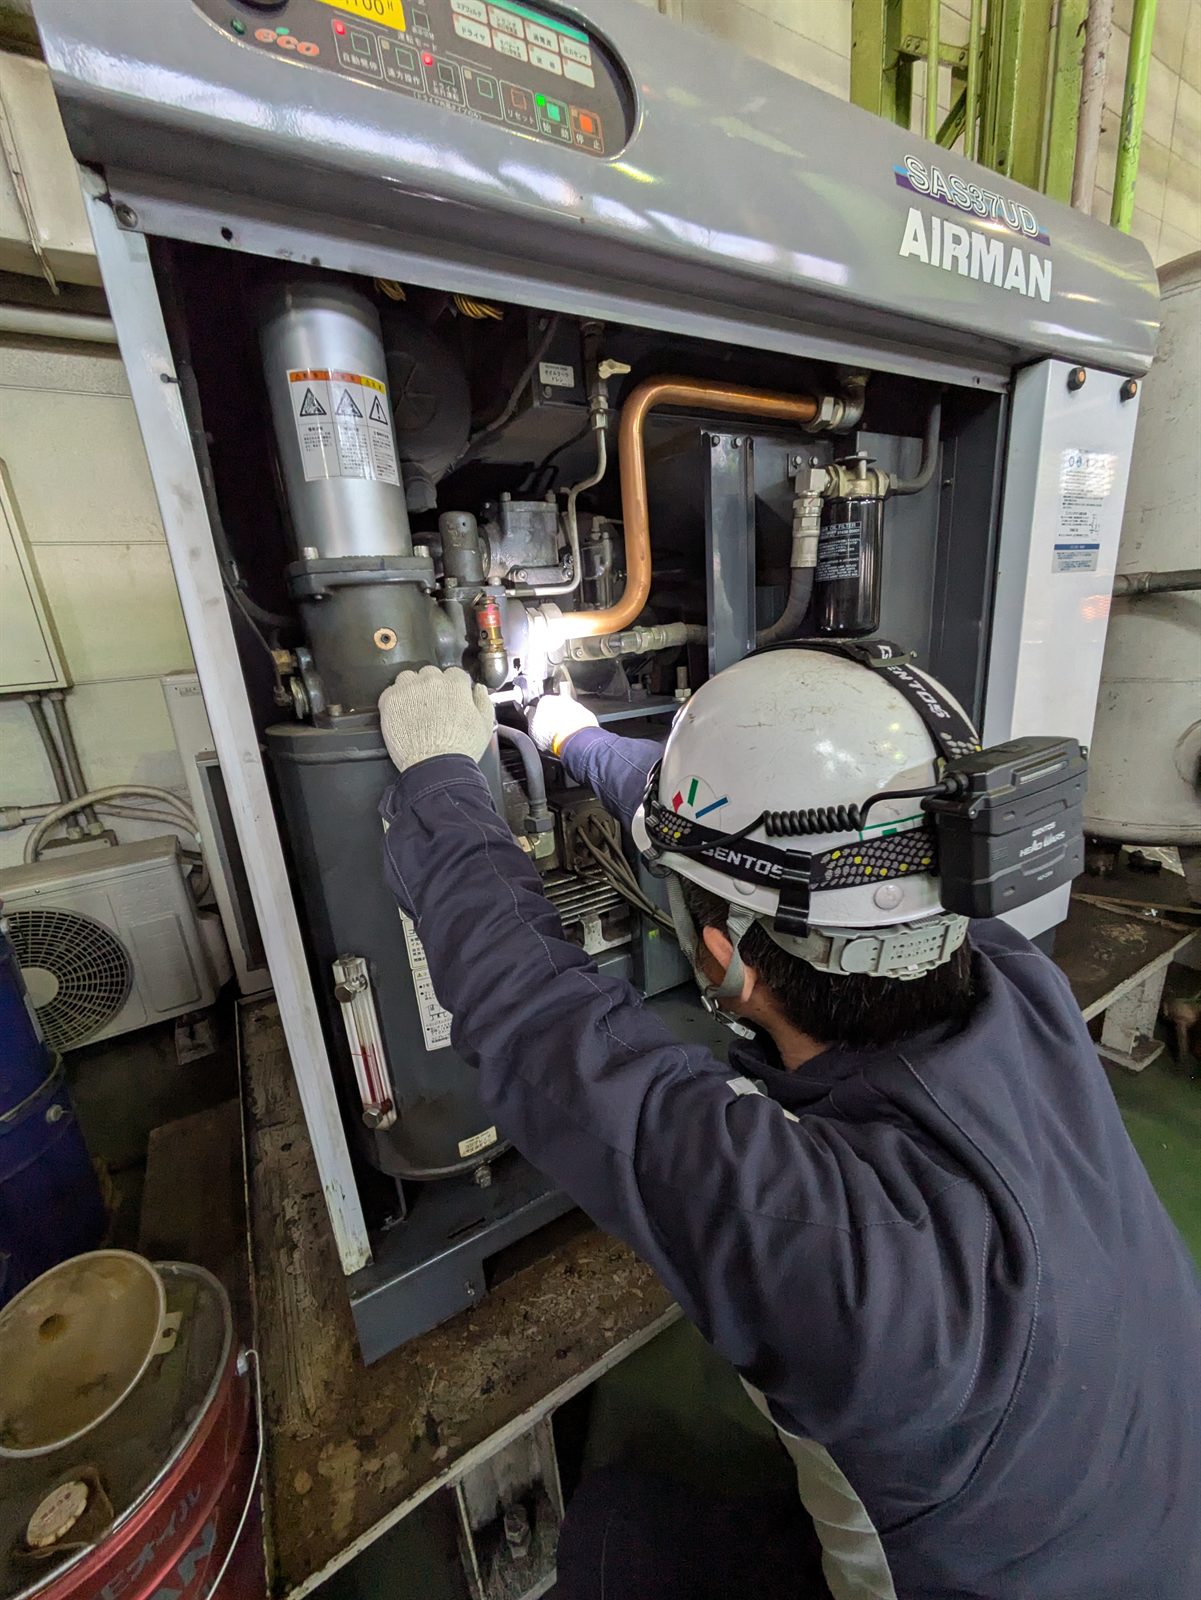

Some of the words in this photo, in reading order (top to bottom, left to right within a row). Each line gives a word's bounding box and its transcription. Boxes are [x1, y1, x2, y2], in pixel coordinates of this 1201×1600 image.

[255, 28, 320, 57] eco
[507, 109, 534, 125] リセット
[904, 155, 1039, 238] SAS37UD
[899, 207, 1052, 303] AIRMAN
